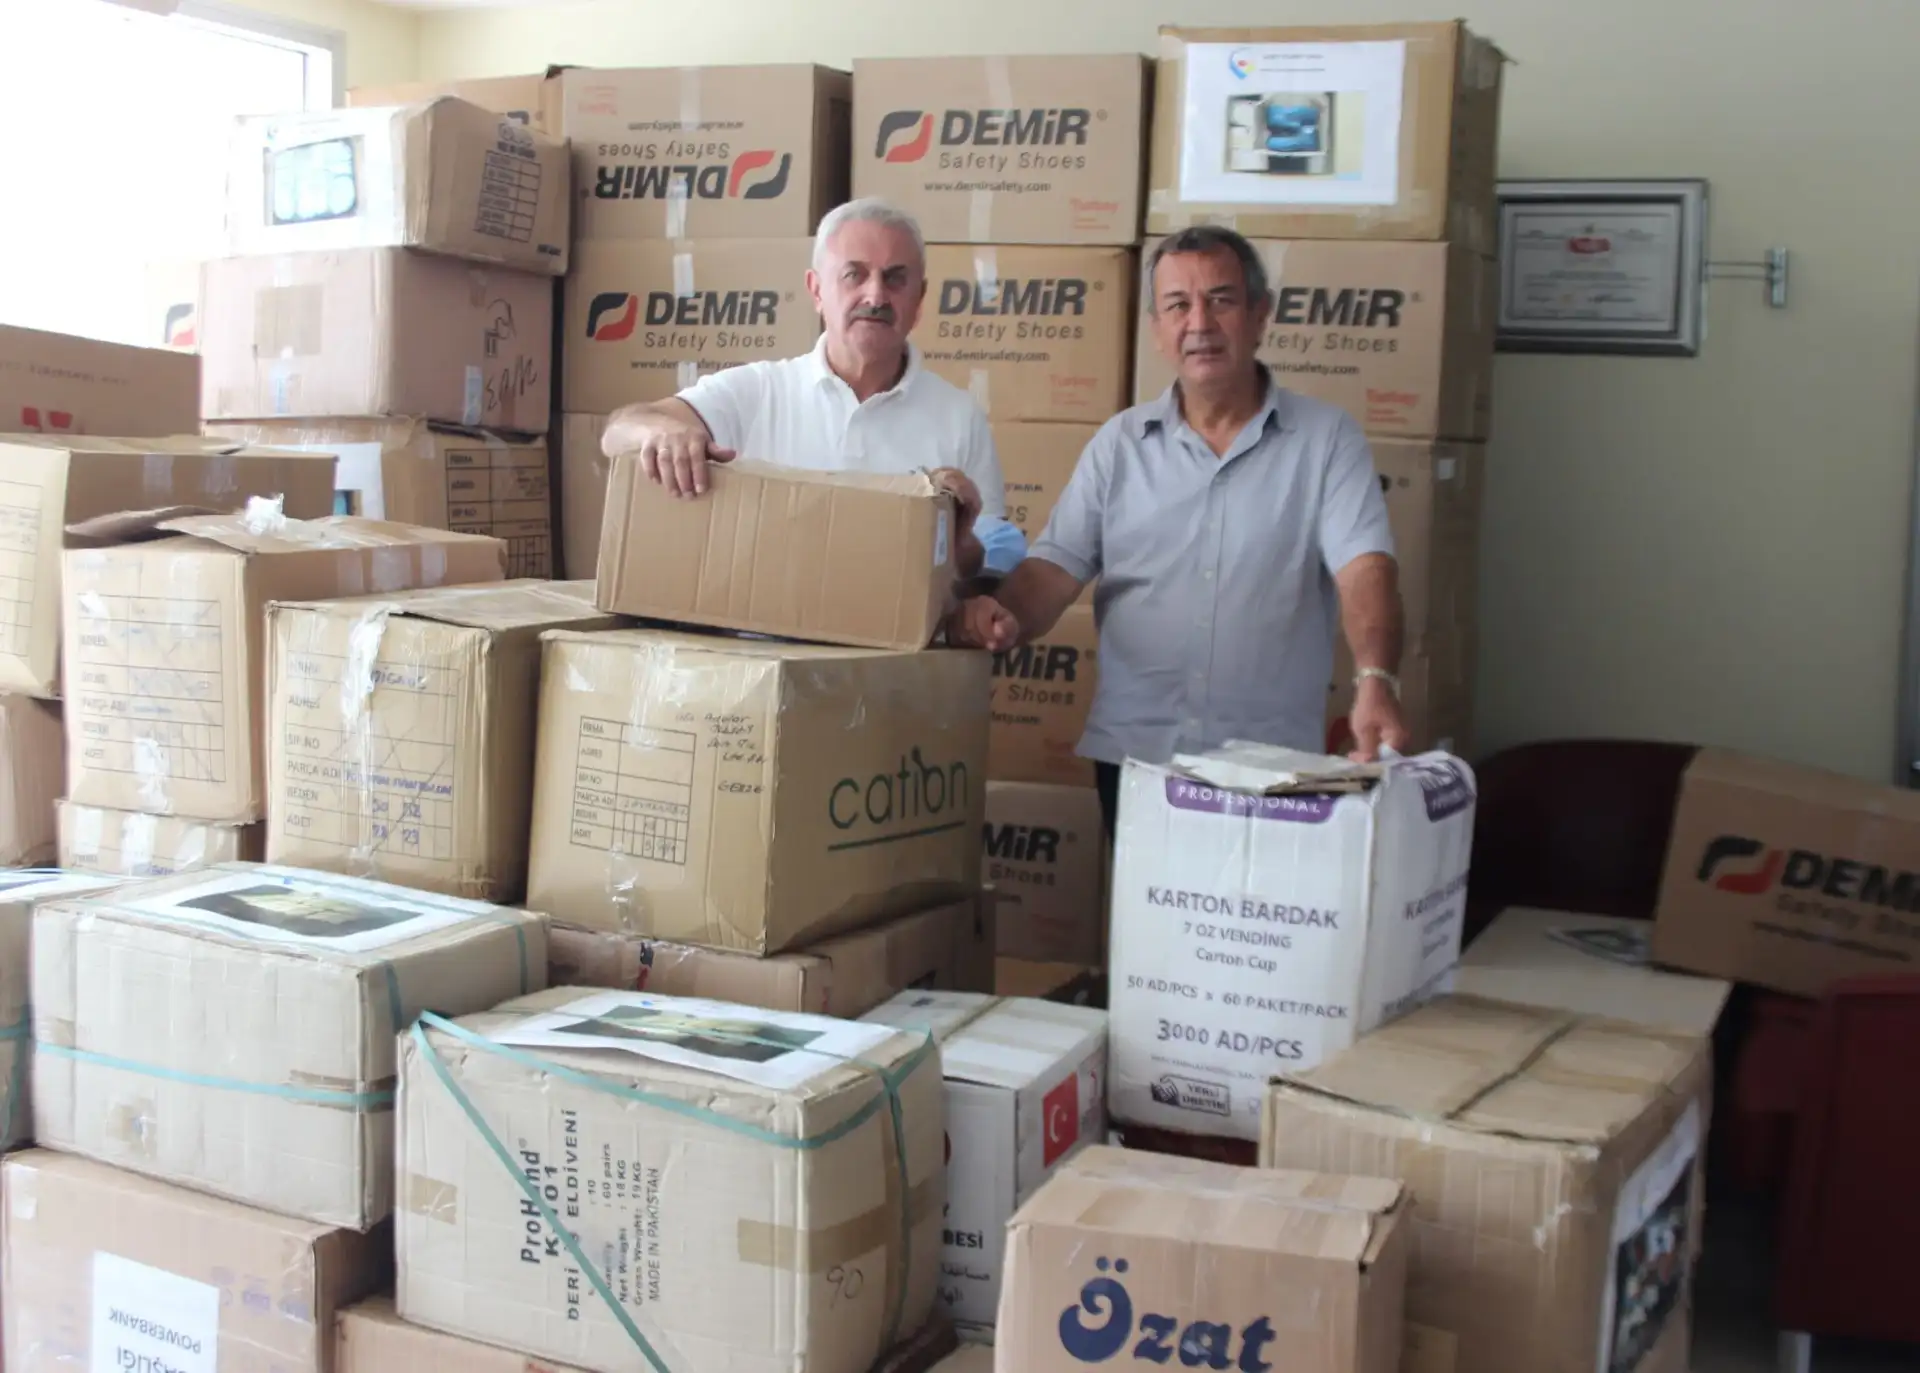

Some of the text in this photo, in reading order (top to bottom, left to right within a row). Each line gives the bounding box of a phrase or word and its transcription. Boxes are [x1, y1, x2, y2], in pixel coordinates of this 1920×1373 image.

[940, 109, 1092, 147] DEMiR
[598, 141, 731, 161] Safety Shoes
[938, 152, 1086, 173] Safety Shoes
[924, 181, 1052, 194] www.demirsafety.com
[645, 291, 780, 326] DEMiR
[1275, 287, 1405, 328] EMiR
[644, 331, 776, 352] Safety Shoes
[938, 321, 1085, 342] Safety Shoes
[1267, 333, 1399, 354] fety Shoes
[991, 645, 1078, 683] MiR
[1008, 684, 1076, 705] Shoes
[287, 761, 319, 777] PARÇA
[829, 745, 967, 829] cation
[1179, 785, 1321, 814] PROFESSIONAL
[982, 822, 1061, 864] MiR
[1780, 849, 1920, 914] DEM
[1147, 886, 1340, 930] KARTON BARDAK
[1183, 920, 1193, 935] 7
[1195, 923, 1217, 939] OZ
[1196, 946, 1278, 974] Carton Cup
[1127, 974, 1144, 989] 50
[1147, 978, 1199, 999] AD/PCS
[1222, 991, 1241, 1006] 60
[1245, 995, 1349, 1019] PAKET/PACK
[1156, 1018, 1304, 1060] 3000 AD/PCS
[601, 1142, 613, 1179] pairs
[616, 1158, 627, 1180] KG
[631, 1161, 642, 1183] KG
[588, 1179, 597, 1195] 10
[602, 1181, 612, 1199] 60
[631, 1185, 642, 1200] 19
[561, 1108, 580, 1321] DERİ ELDİVENİ
[644, 1166, 662, 1302] MADE IN PAKISTAN
[942, 1229, 984, 1249] BESİ
[617, 1278, 628, 1303] Net
[632, 1265, 643, 1306] Gross
[827, 1264, 864, 1299] 90
[1059, 1255, 1276, 1373] Özat
[108, 1306, 203, 1355] POWERBANK
